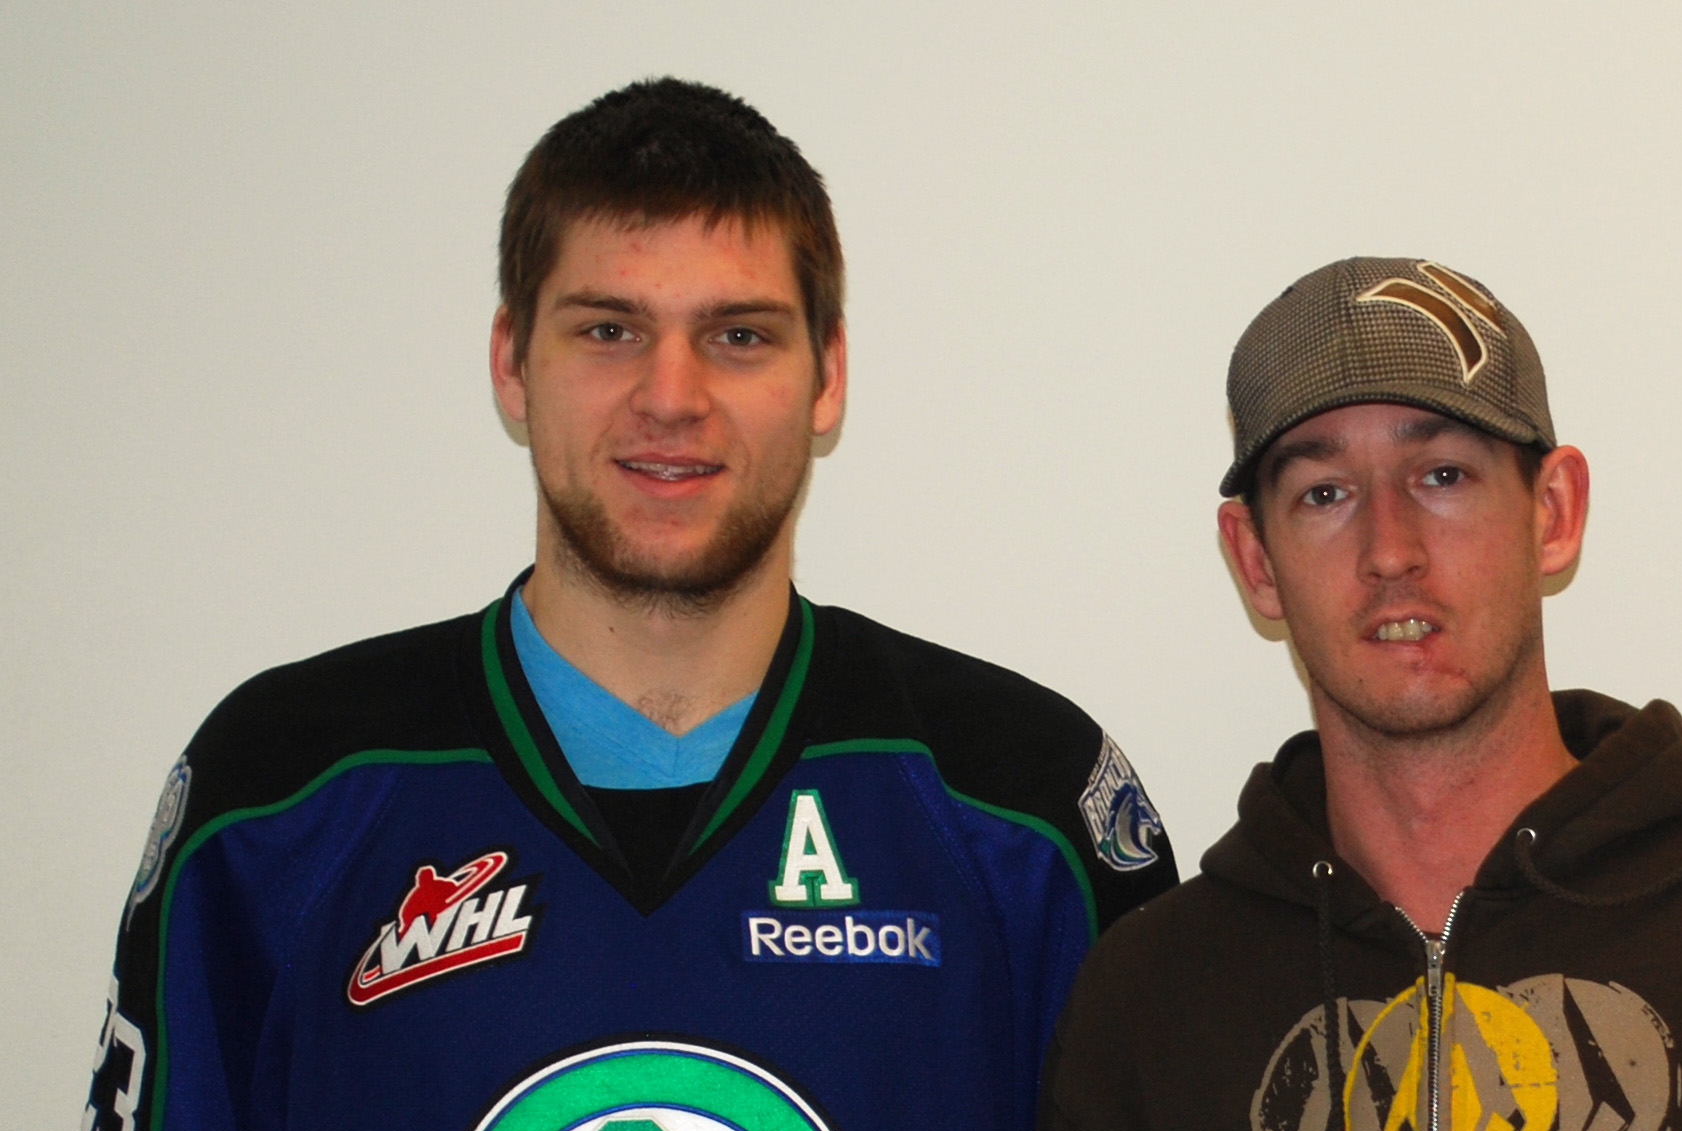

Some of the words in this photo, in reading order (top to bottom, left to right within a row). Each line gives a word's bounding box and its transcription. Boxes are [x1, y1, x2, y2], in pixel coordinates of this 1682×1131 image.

[772, 791, 857, 902] A
[379, 884, 533, 975] WHL
[748, 916, 934, 961] Reebok
